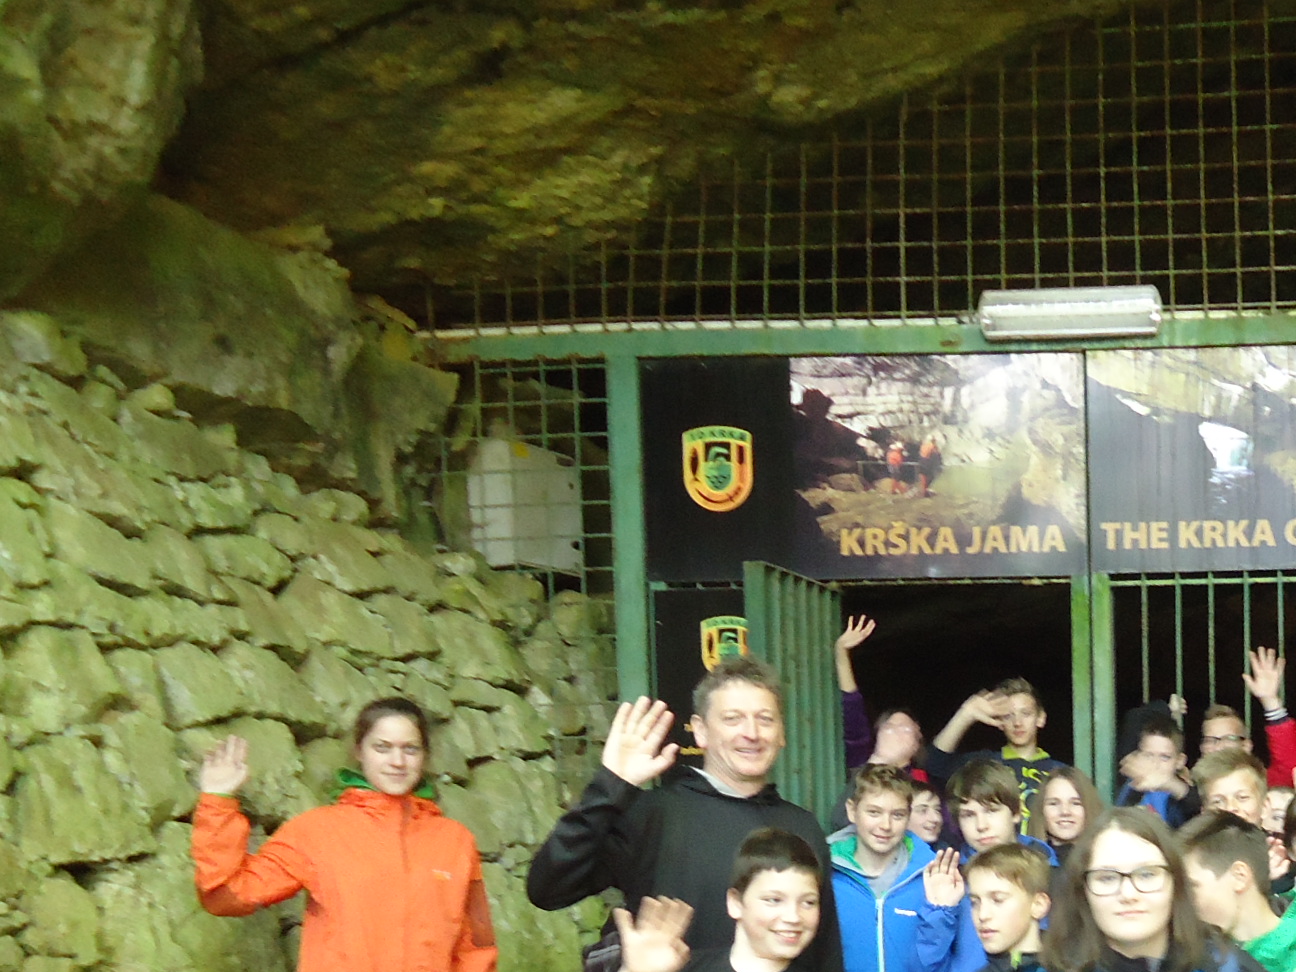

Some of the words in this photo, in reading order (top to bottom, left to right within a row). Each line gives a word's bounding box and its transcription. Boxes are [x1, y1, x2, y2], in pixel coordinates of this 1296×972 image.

[839, 521, 960, 556] KRŠKA
[965, 524, 1068, 554] JAMA
[1100, 521, 1170, 550] THE
[1177, 518, 1277, 549] KRKA
